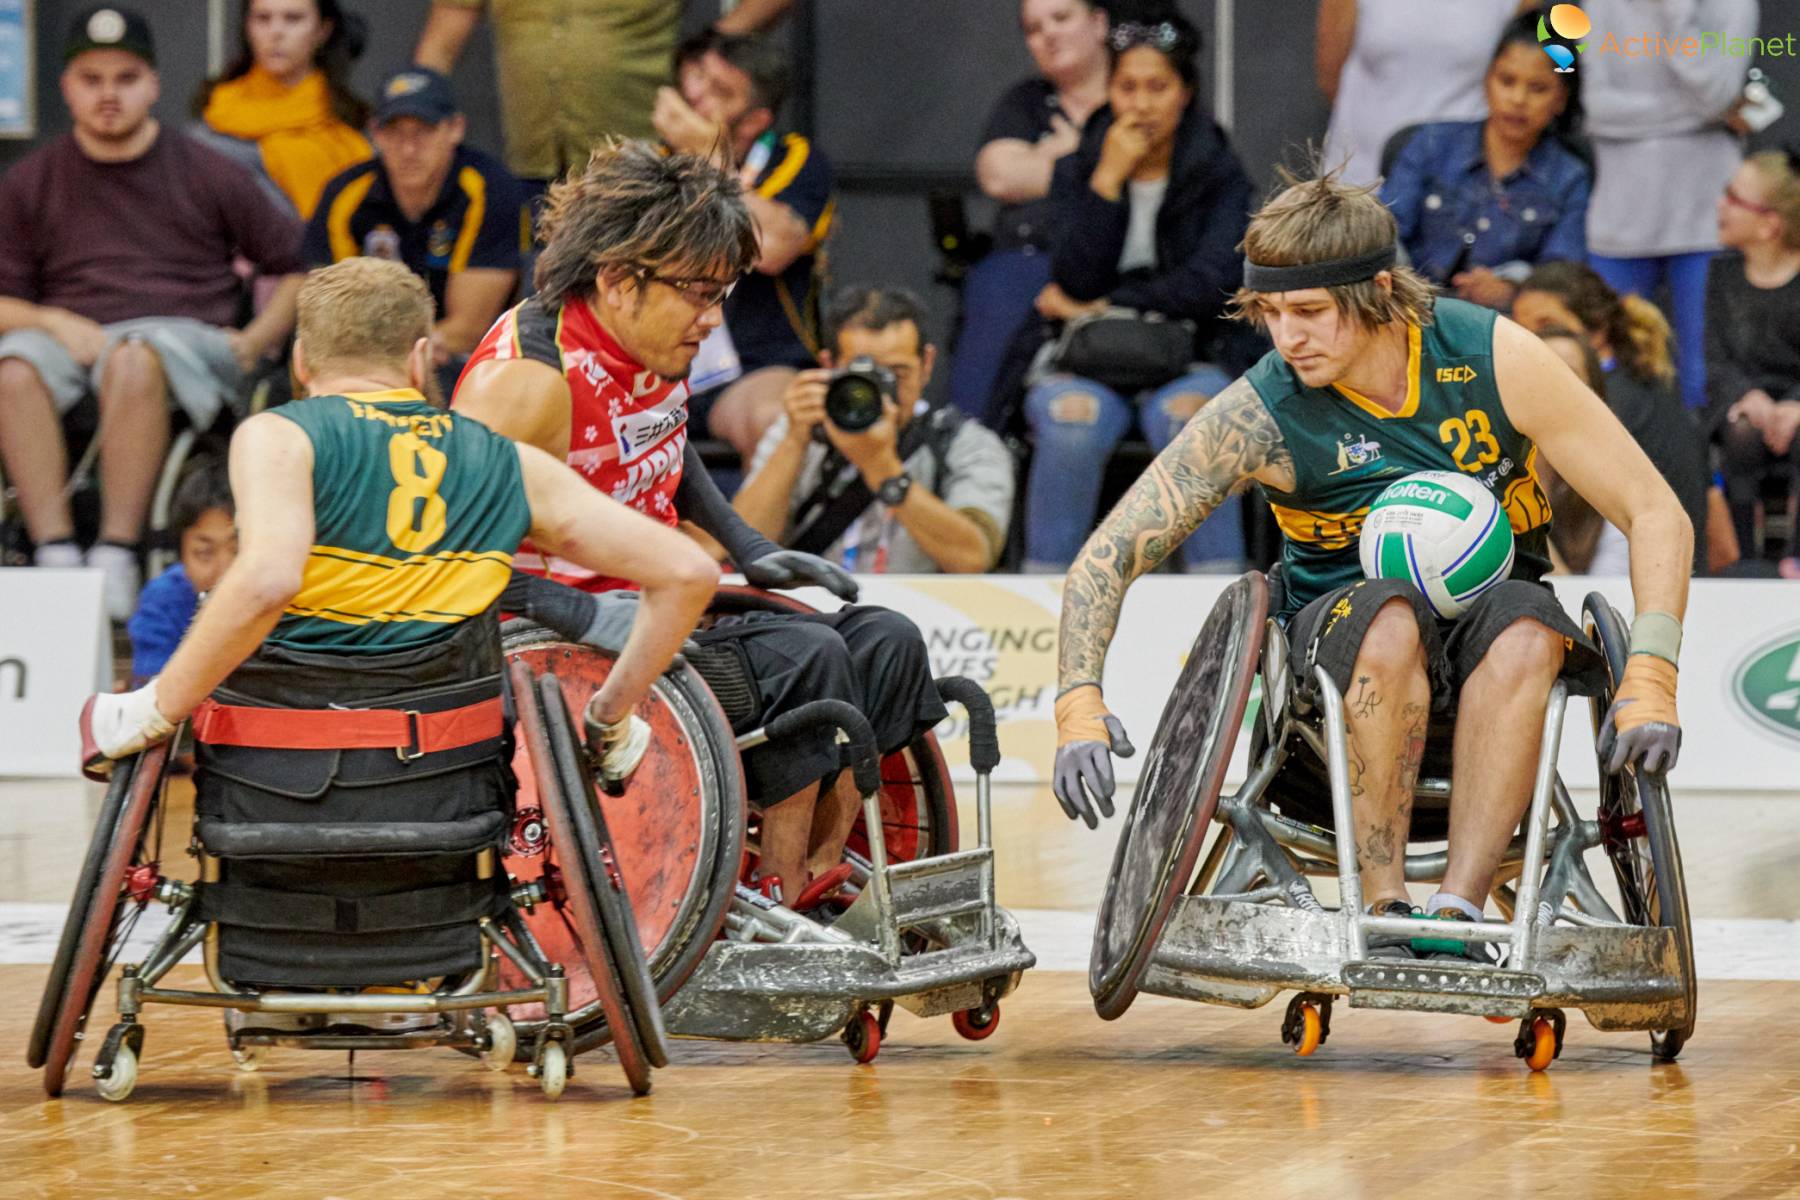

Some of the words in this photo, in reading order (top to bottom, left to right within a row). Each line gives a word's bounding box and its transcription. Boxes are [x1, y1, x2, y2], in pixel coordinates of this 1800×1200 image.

[1436, 366, 1464, 383] ISC
[1438, 408, 1500, 473] 23
[386, 432, 448, 554] 8
[1373, 481, 1447, 505] molten
[928, 626, 1056, 653] NGING
[936, 657, 998, 680] VES
